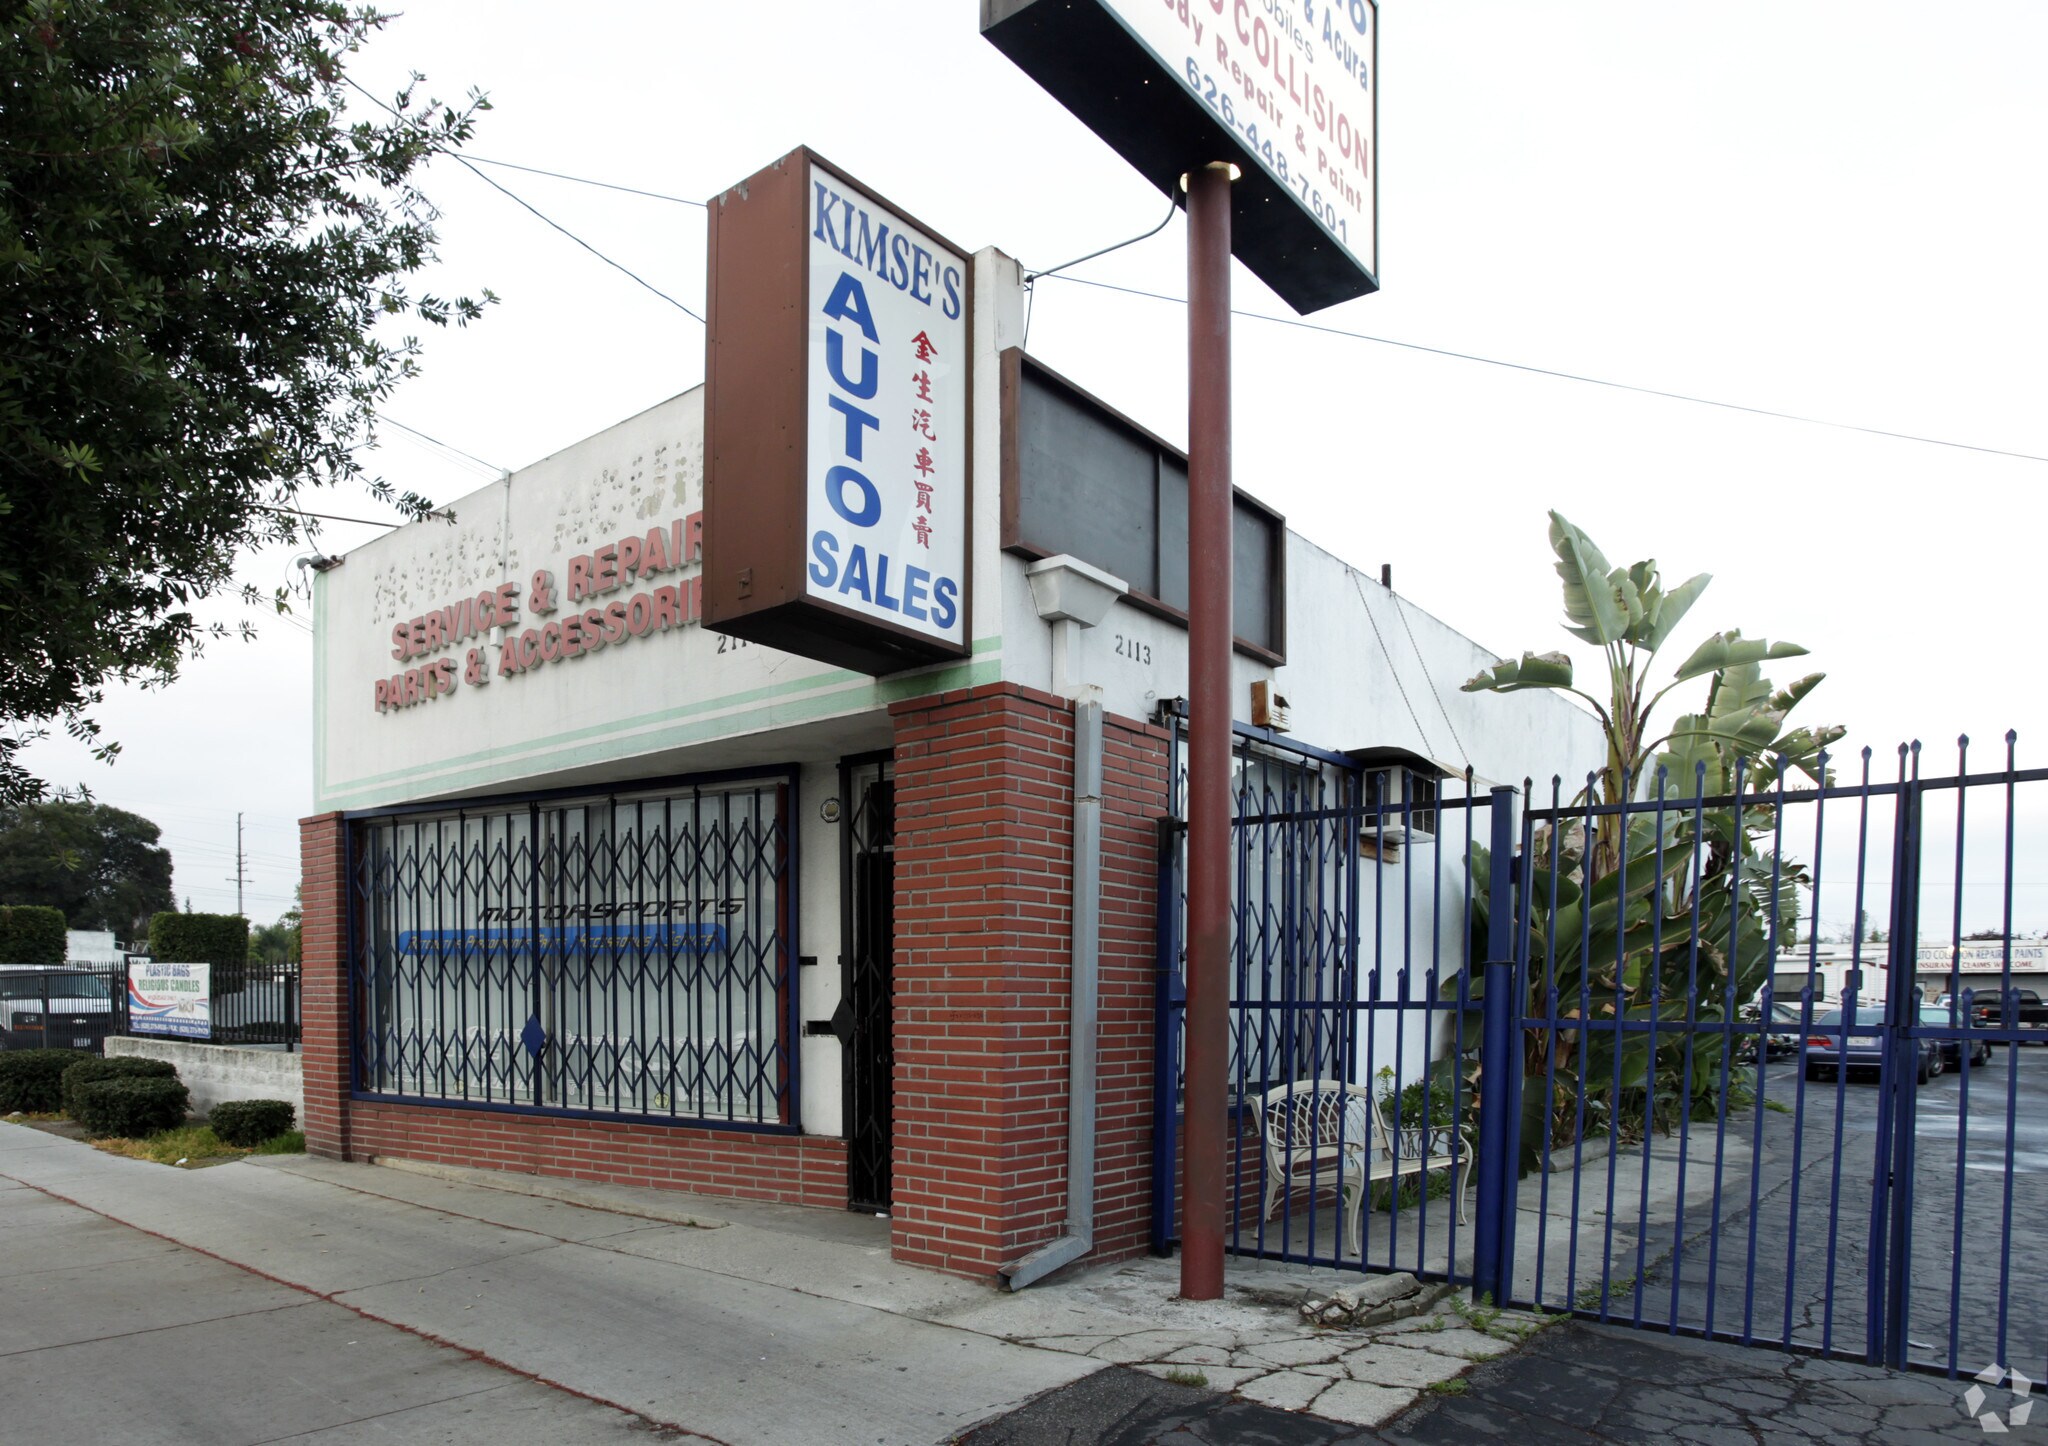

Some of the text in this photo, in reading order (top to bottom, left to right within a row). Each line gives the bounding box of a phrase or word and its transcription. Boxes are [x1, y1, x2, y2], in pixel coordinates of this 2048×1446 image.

[1262, 0, 1314, 64] obiles
[1322, 7, 1368, 92] Acura
[1215, 33, 1284, 129] Repair
[1294, 123, 1307, 158] &
[1317, 147, 1363, 214] Paint
[1233, 0, 1369, 180] COLLISION
[1185, 55, 1348, 245] 626-448-7601
[813, 180, 962, 320] KIMSE'S
[822, 270, 882, 528] AUTO
[391, 581, 518, 663] SERVICE
[529, 569, 557, 616] &
[808, 529, 959, 630] SALES
[374, 659, 457, 713] PARTS
[464, 647, 489, 687] &
[1114, 634, 1151, 666] 2113
[138, 979, 200, 993] RELIGIOUS CANDLES
[145, 964, 191, 978] PLASTIC BAGS
[1962, 960, 1991, 968] CLAIMS
[2015, 948, 2043, 959] PAINTS
